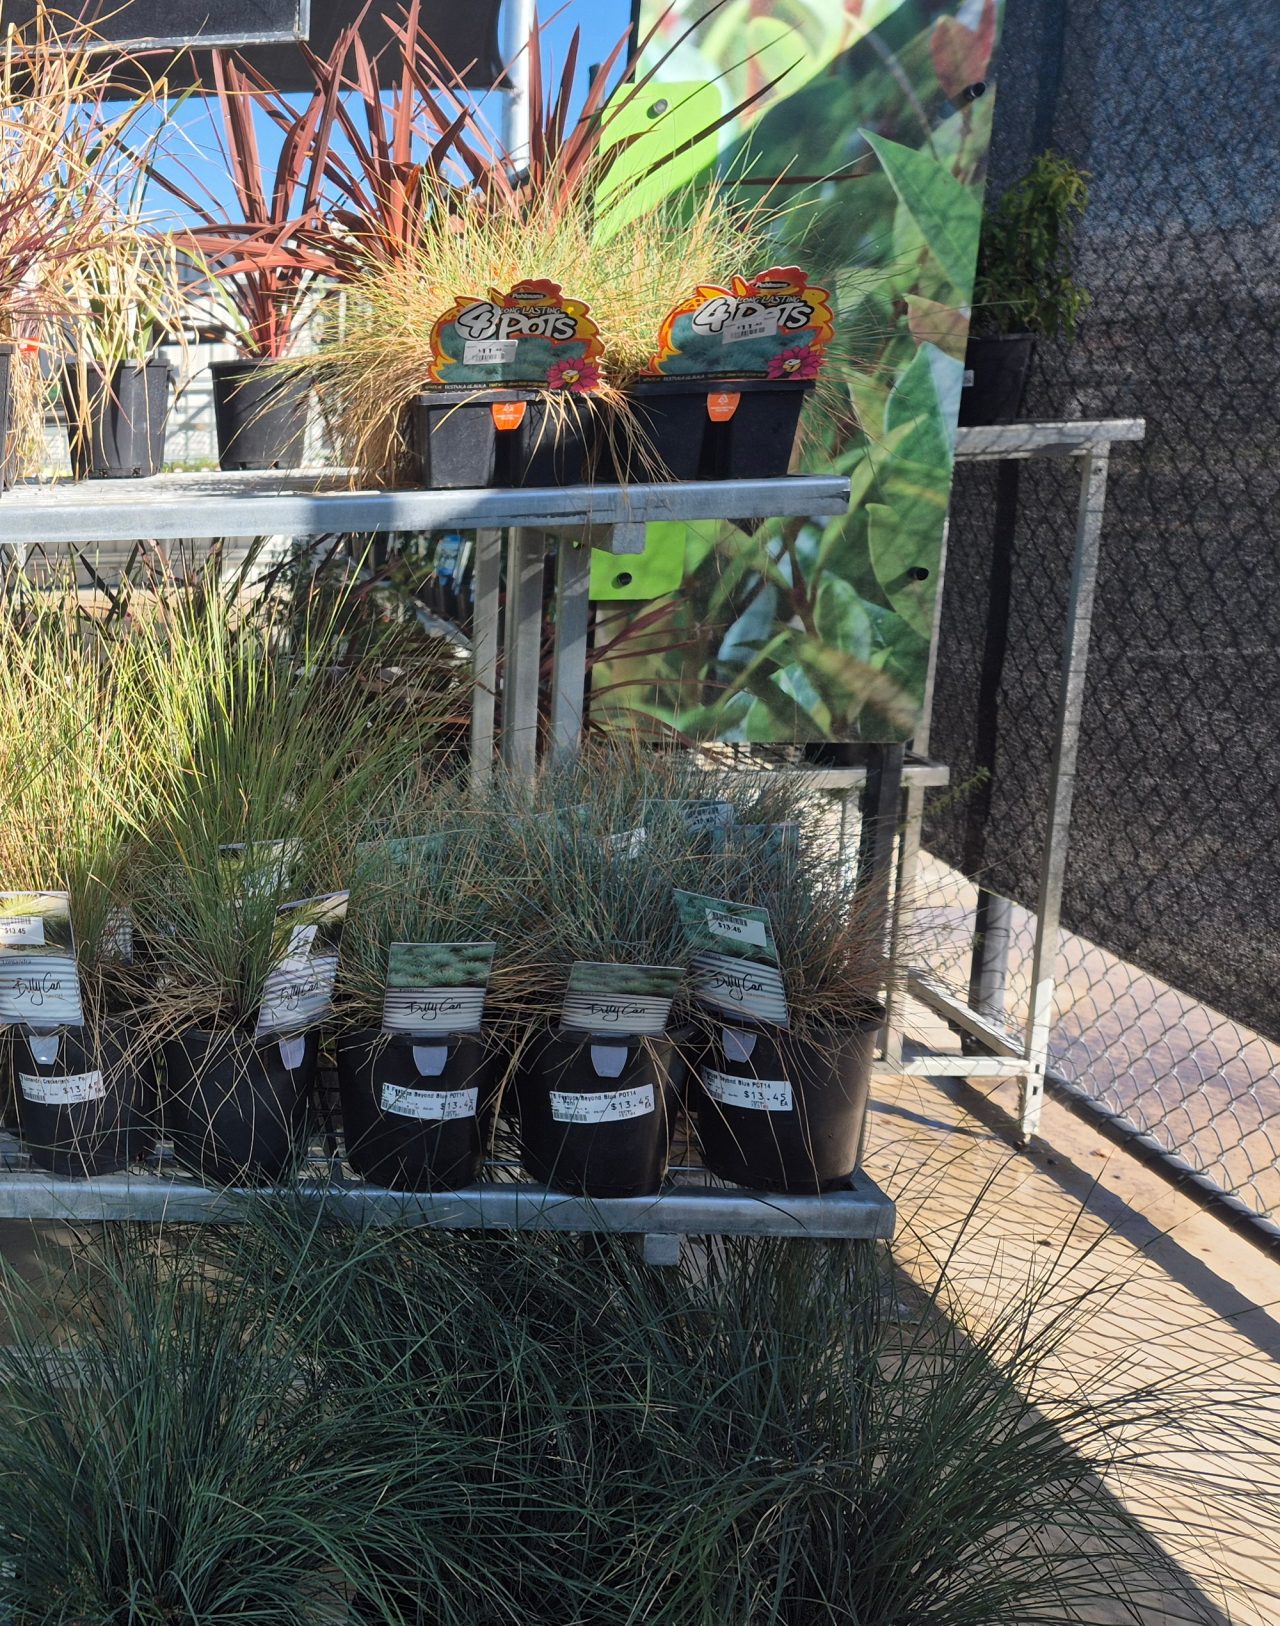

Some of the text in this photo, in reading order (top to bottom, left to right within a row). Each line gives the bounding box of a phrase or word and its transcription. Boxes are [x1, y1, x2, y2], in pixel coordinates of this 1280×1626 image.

[4, 926, 26, 936] $13.45
[12, 971, 62, 1006] Billy Can
[742, 973, 764, 992] Can
[403, 997, 463, 1021] Billy Can
[583, 1002, 647, 1022] Billy Can
[738, 1079, 751, 1088] Blue
[413, 1091, 435, 1099] Beyond
[580, 1094, 602, 1102] Beyond
[618, 1090, 637, 1099] POT14
[743, 1089, 787, 1102] $13.45
[610, 1095, 650, 1111] $13.45
